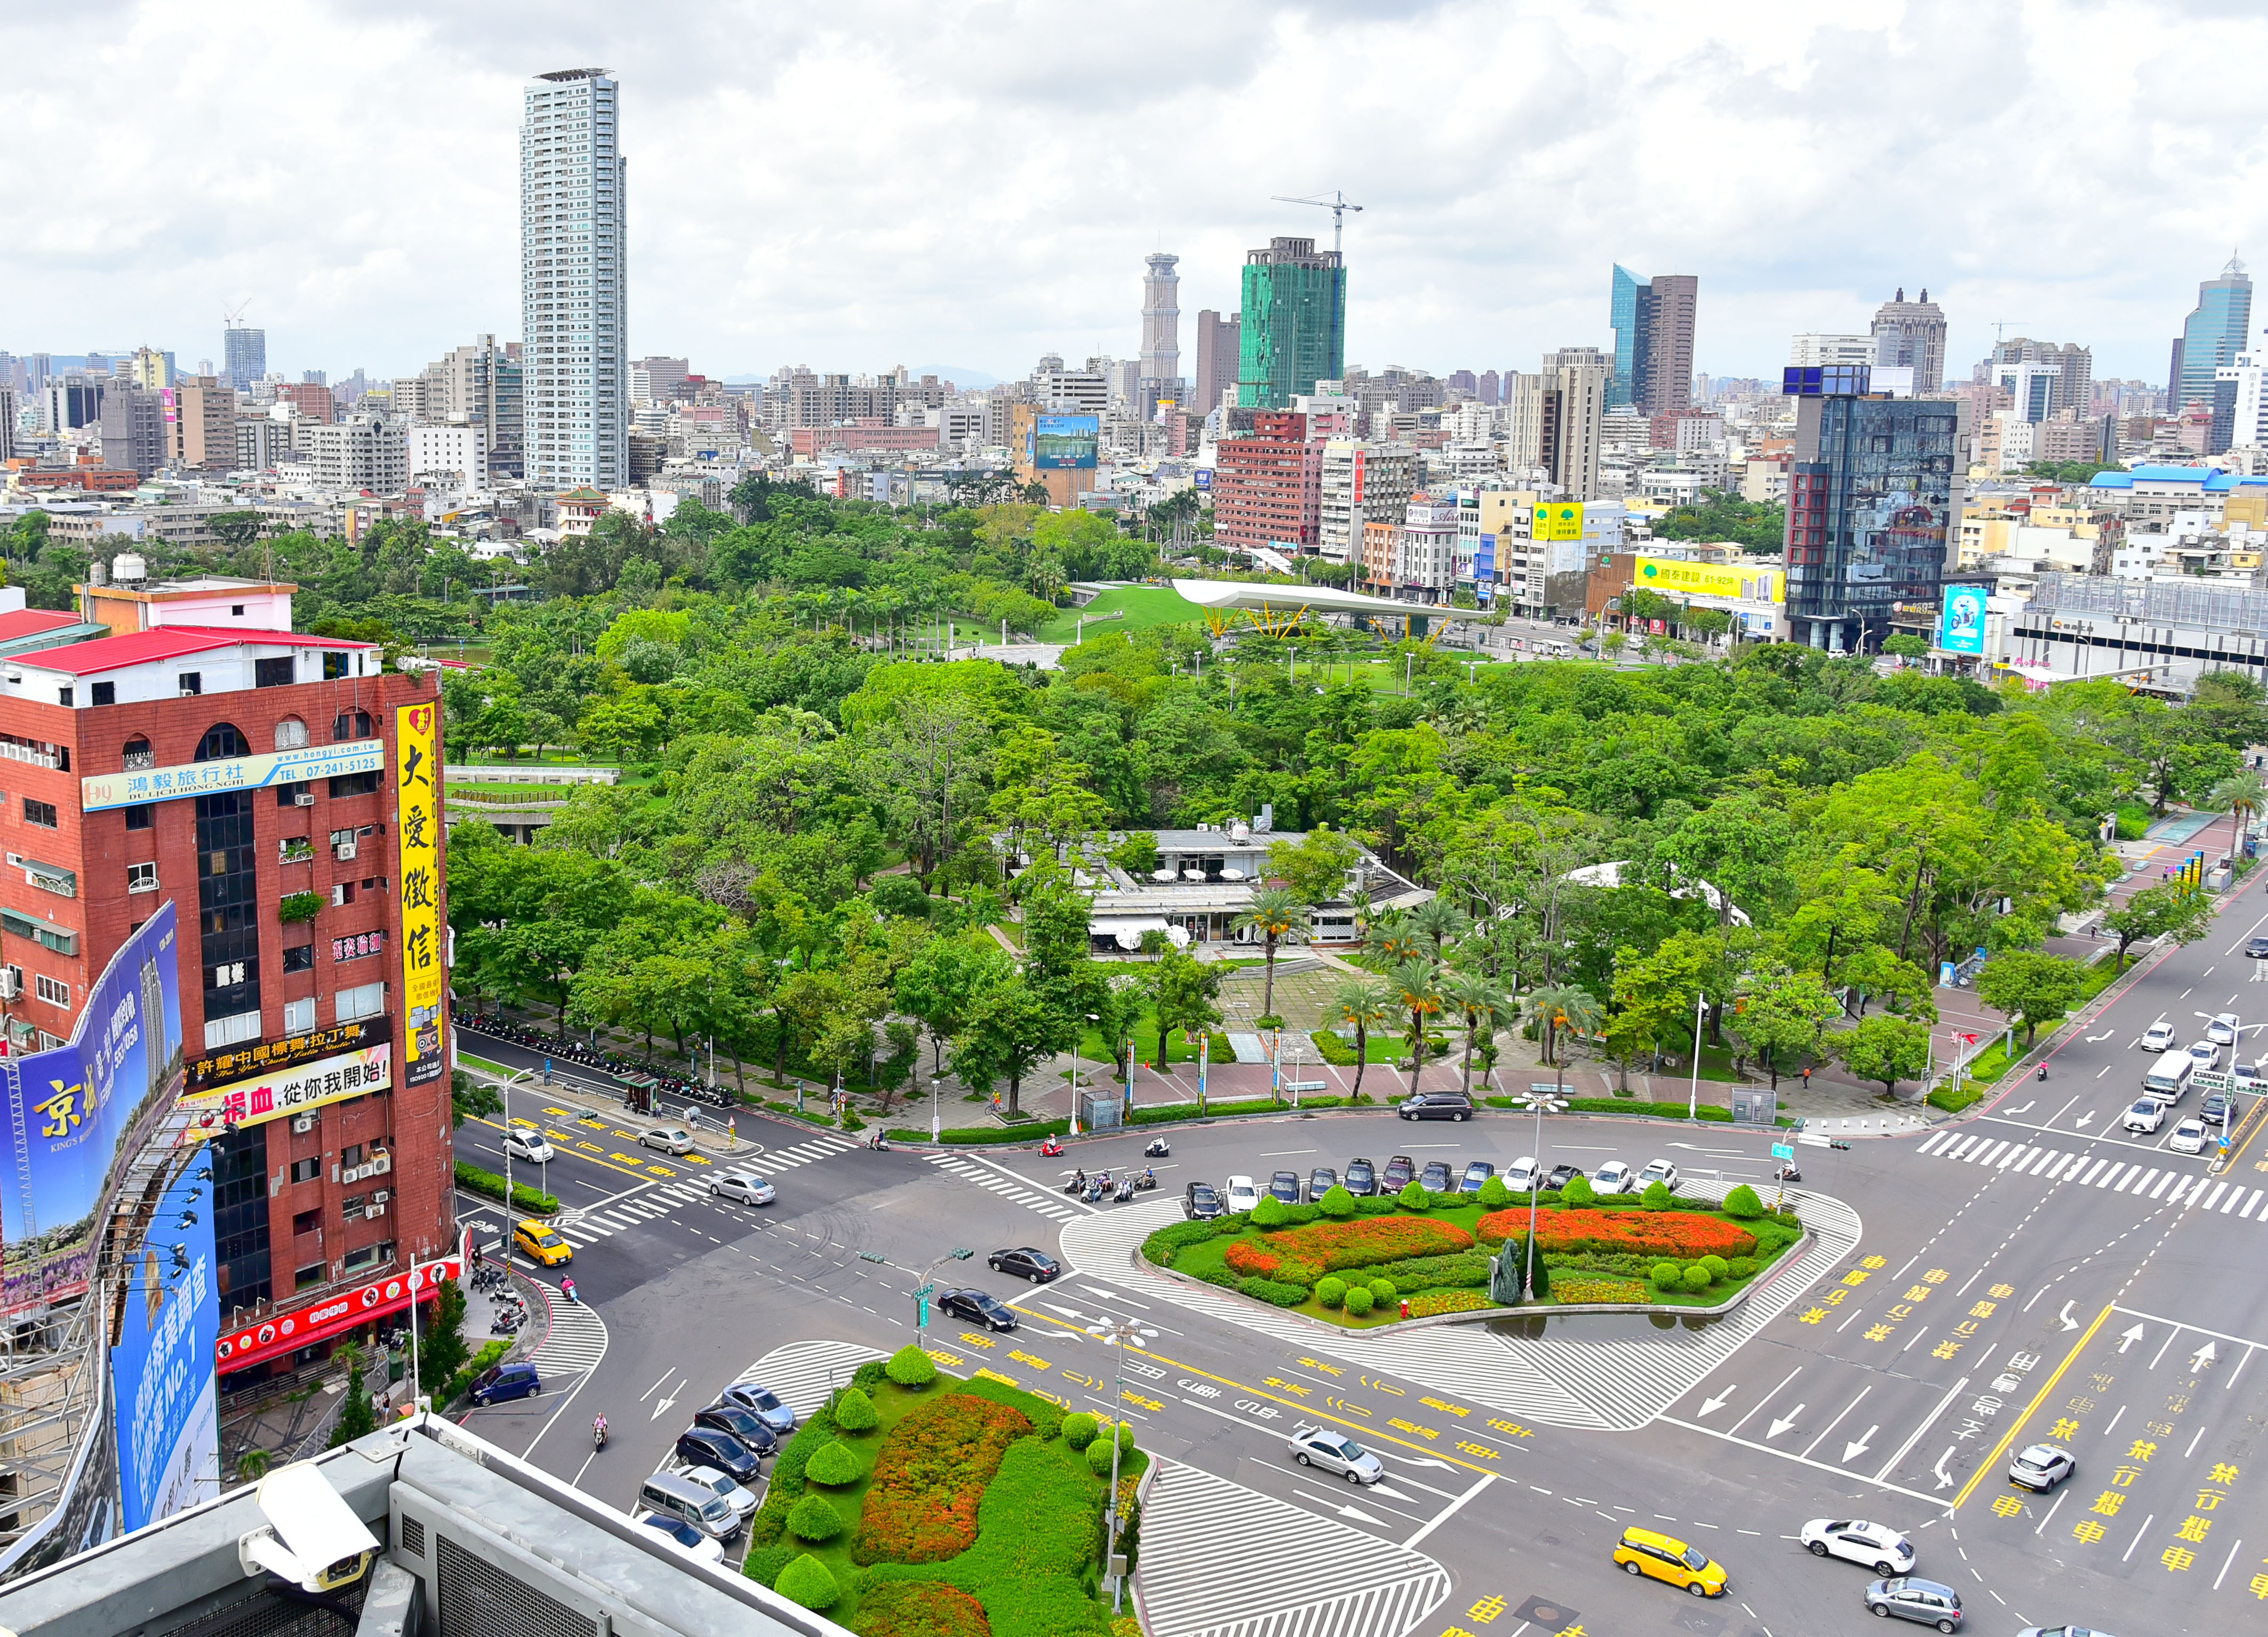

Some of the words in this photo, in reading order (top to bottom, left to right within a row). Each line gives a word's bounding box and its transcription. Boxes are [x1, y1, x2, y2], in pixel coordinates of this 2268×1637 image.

[1660, 568, 1700, 582] 國泰建設
[127, 763, 245, 793] 鴻毅旅行社
[277, 743, 375, 763] www.hongyi.com.tw
[307, 757, 376, 778] 07-241-5125
[402, 744, 433, 971] 大愛徵信
[1862, 1268, 1951, 1342] 禁行機車
[1931, 1283, 2016, 1360] 禁行機車
[2072, 1438, 2158, 1544] 禁行機車
[2160, 1462, 2240, 1571] 禁行機車
